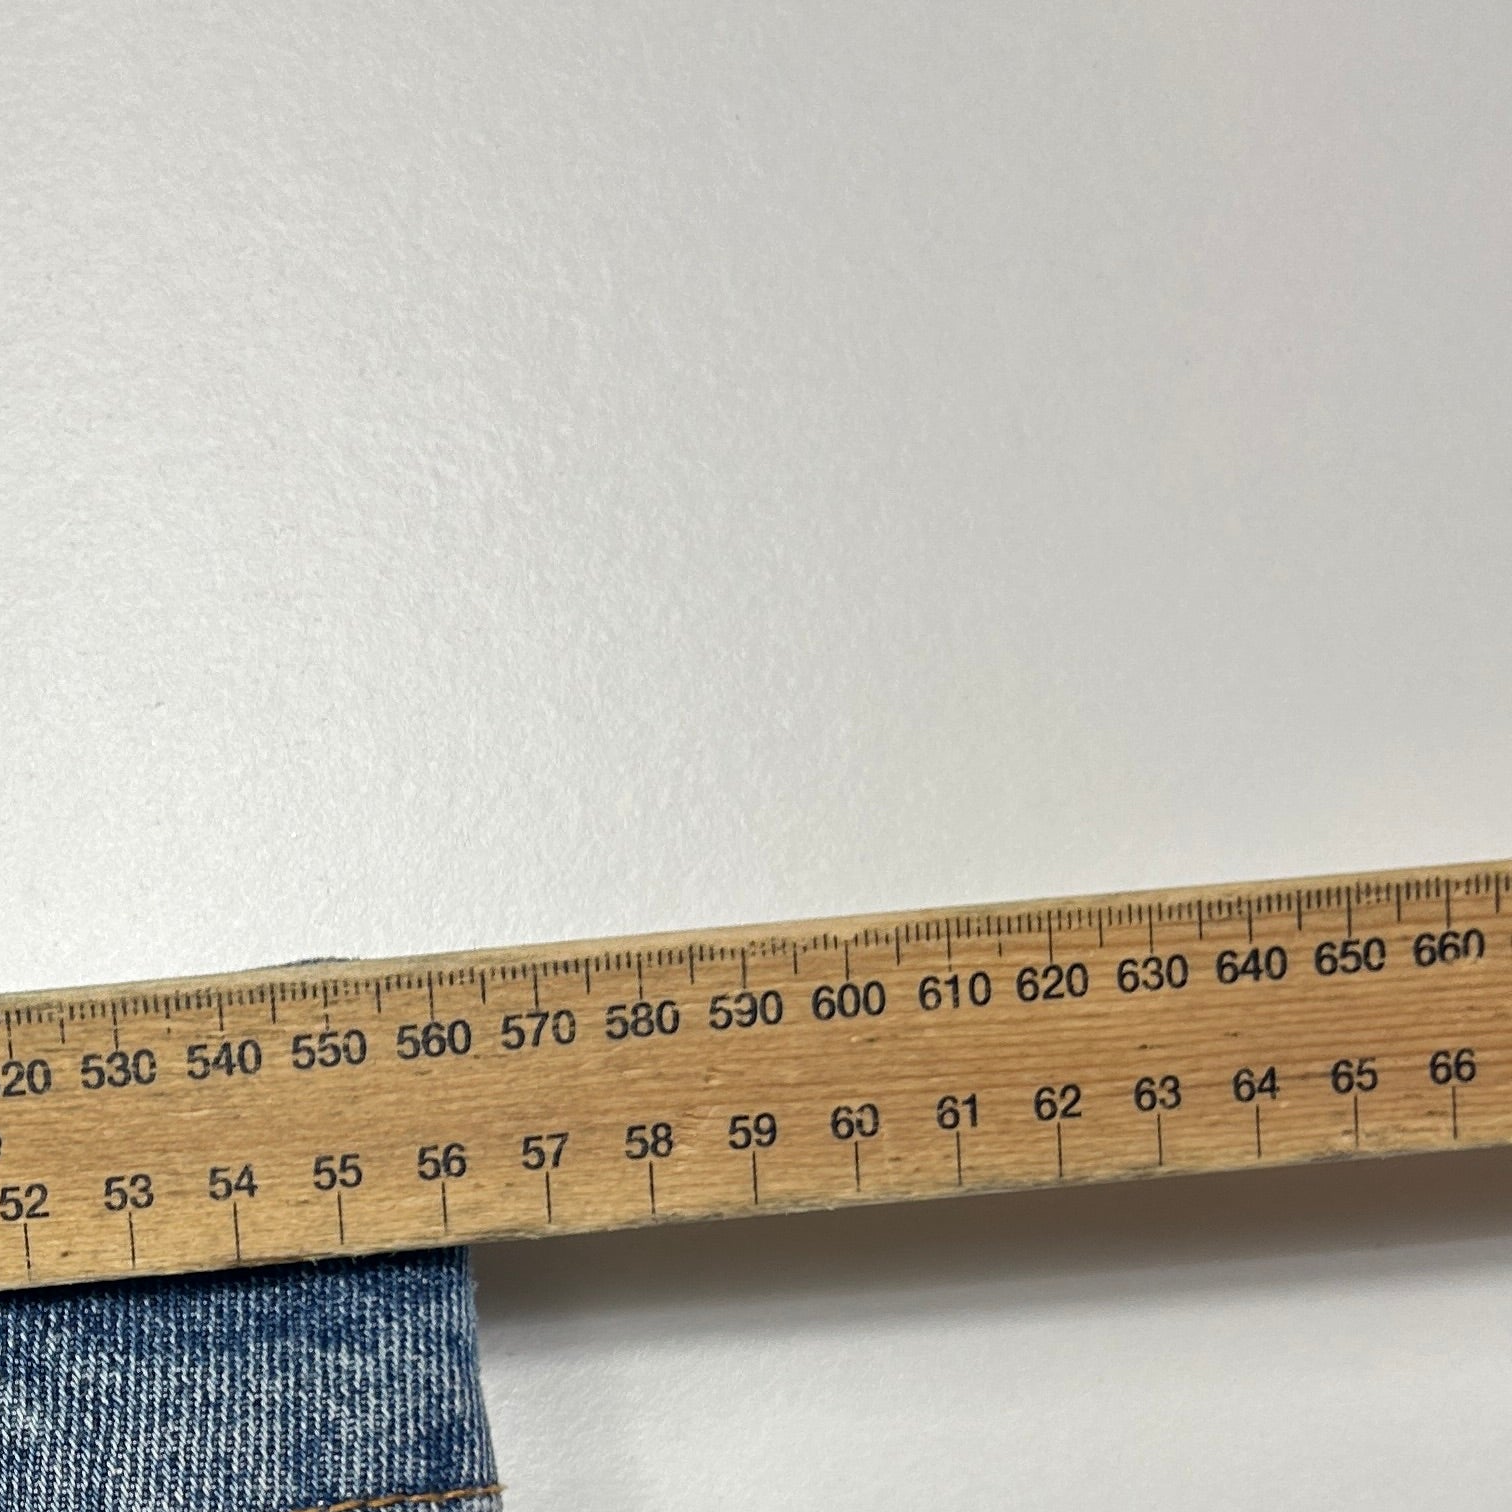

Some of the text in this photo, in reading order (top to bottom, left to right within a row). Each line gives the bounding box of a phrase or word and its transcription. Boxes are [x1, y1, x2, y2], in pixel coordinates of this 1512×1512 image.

[80, 1049, 157, 1089] 530
[187, 1039, 262, 1079] 540
[292, 1029, 367, 1069] 550
[396, 1020, 472, 1060] 560
[501, 1009, 576, 1050] 570
[605, 1000, 680, 1040] 580
[708, 989, 784, 1029] 590
[812, 980, 886, 1021] 600
[919, 971, 991, 1011] 610
[1016, 962, 1090, 1003] 620
[1117, 954, 1190, 994] 630
[1215, 945, 1288, 985] 640
[1314, 936, 1386, 978] 650
[1413, 929, 1485, 968] 660
[0, 1184, 49, 1223] 52
[104, 1173, 154, 1212] 53
[209, 1164, 258, 1202] 54
[313, 1153, 363, 1192] 55
[417, 1144, 467, 1182] 56
[521, 1133, 569, 1171] 57
[625, 1123, 674, 1161] 58
[728, 1112, 777, 1151] 59
[830, 1103, 880, 1141] 60
[936, 1093, 980, 1131] 61
[1033, 1084, 1083, 1123] 62
[1134, 1076, 1181, 1114] 63
[1233, 1066, 1280, 1104] 64
[1330, 1057, 1380, 1095] 65
[1429, 1048, 1477, 1086] 66
